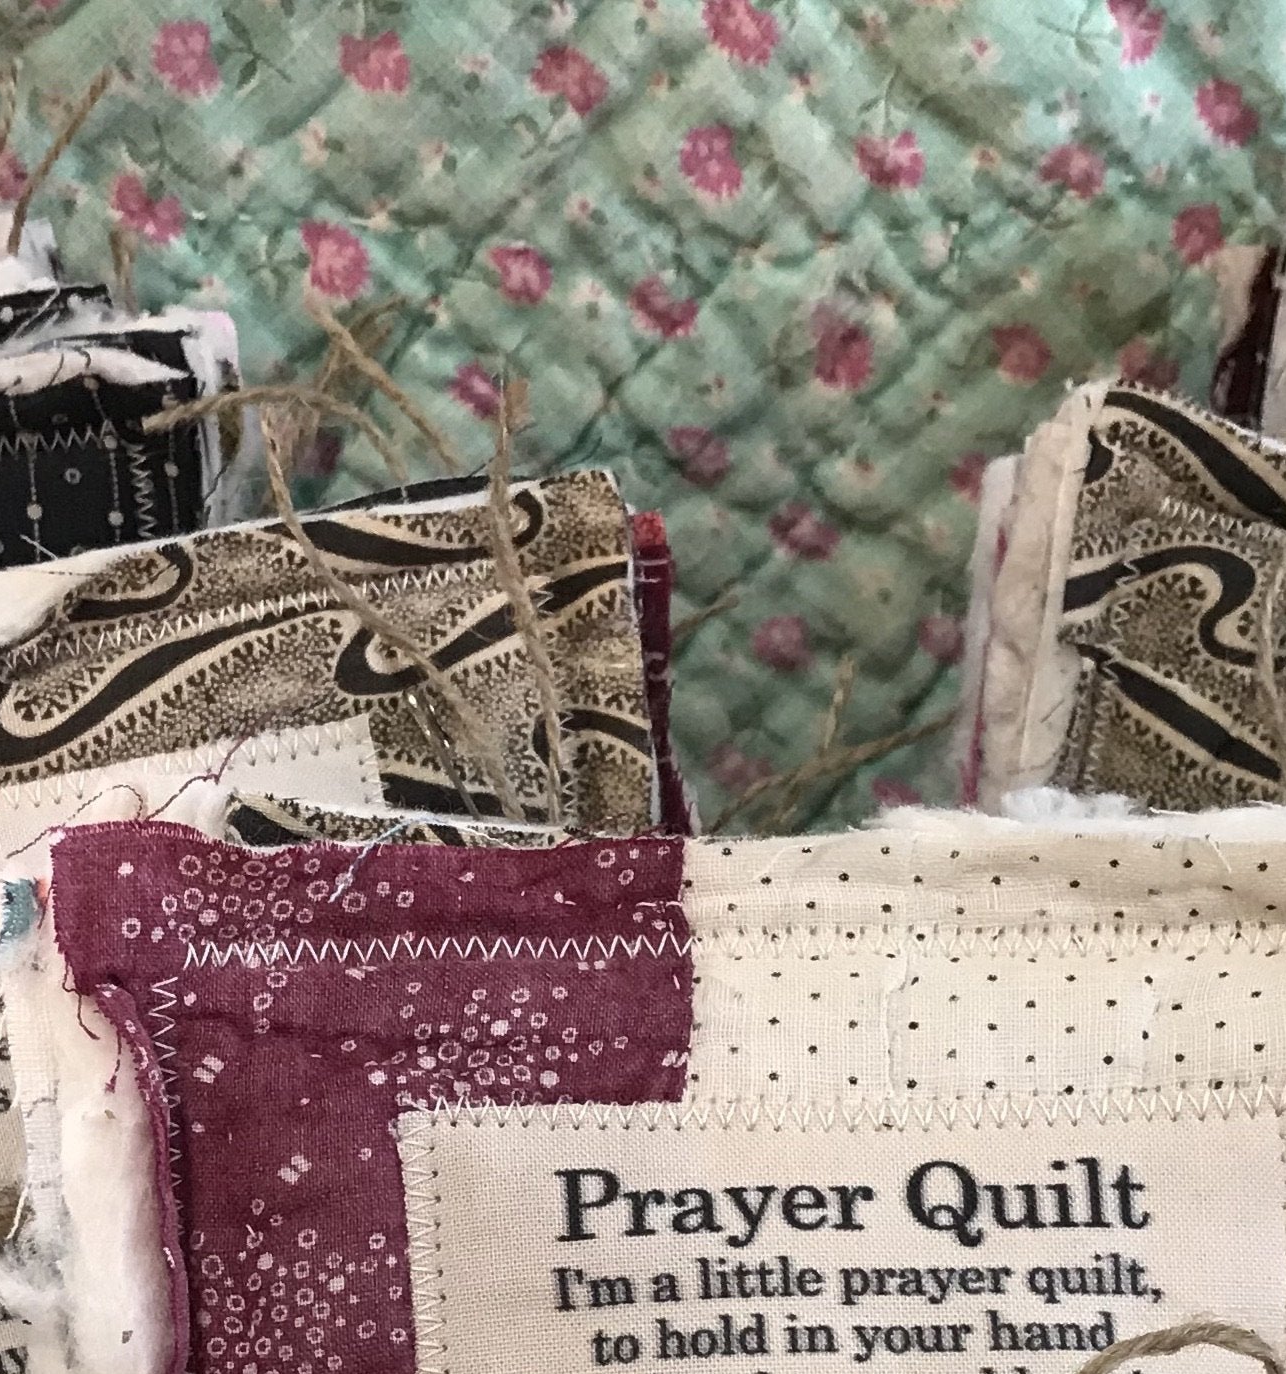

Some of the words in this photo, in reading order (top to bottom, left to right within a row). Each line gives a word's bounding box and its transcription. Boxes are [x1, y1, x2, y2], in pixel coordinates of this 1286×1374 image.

[554, 1166, 875, 1248] Prayer
[906, 1157, 1150, 1247] Quilt
[552, 1266, 636, 1312] I'm
[652, 1272, 681, 1302] a
[696, 1256, 824, 1300] little
[839, 1267, 1012, 1306] prayer
[1027, 1252, 1165, 1304] quilt,
[592, 1329, 640, 1365] to
[656, 1313, 769, 1360] hold
[785, 1312, 839, 1353] in
[853, 1323, 972, 1362] your
